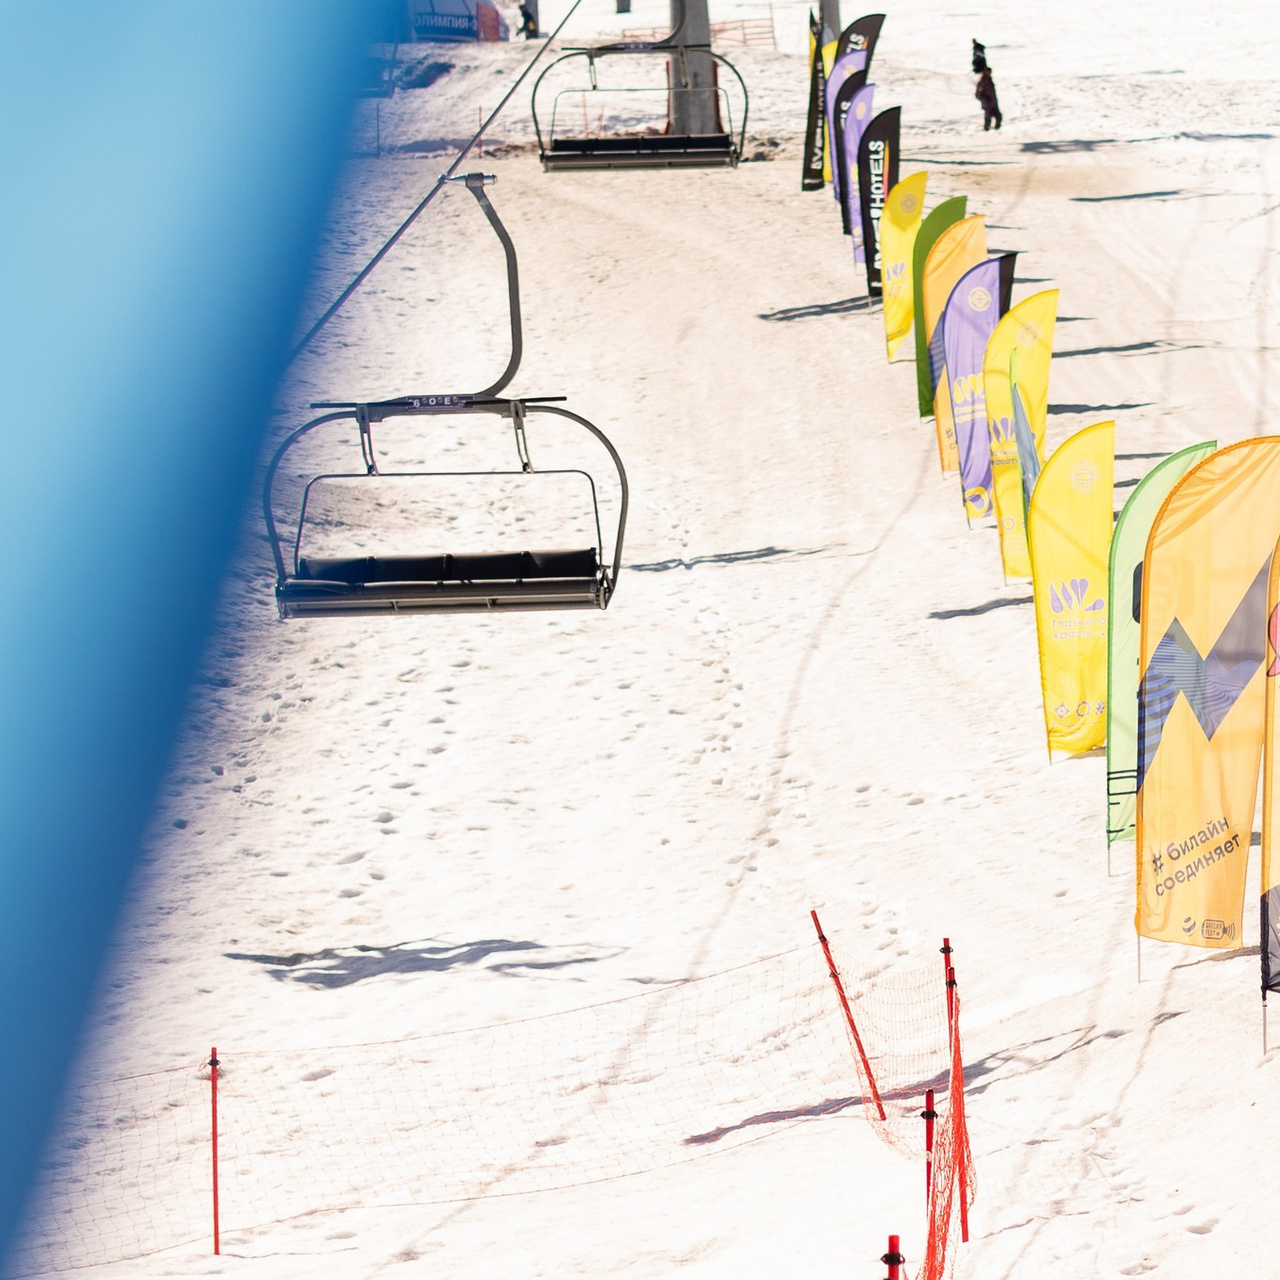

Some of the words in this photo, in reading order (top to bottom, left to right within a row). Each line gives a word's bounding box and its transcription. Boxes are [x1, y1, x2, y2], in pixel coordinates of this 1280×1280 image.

[1152, 851, 1164, 876] #
[1166, 816, 1230, 861] билайн
[1155, 833, 1240, 896] соединяет
